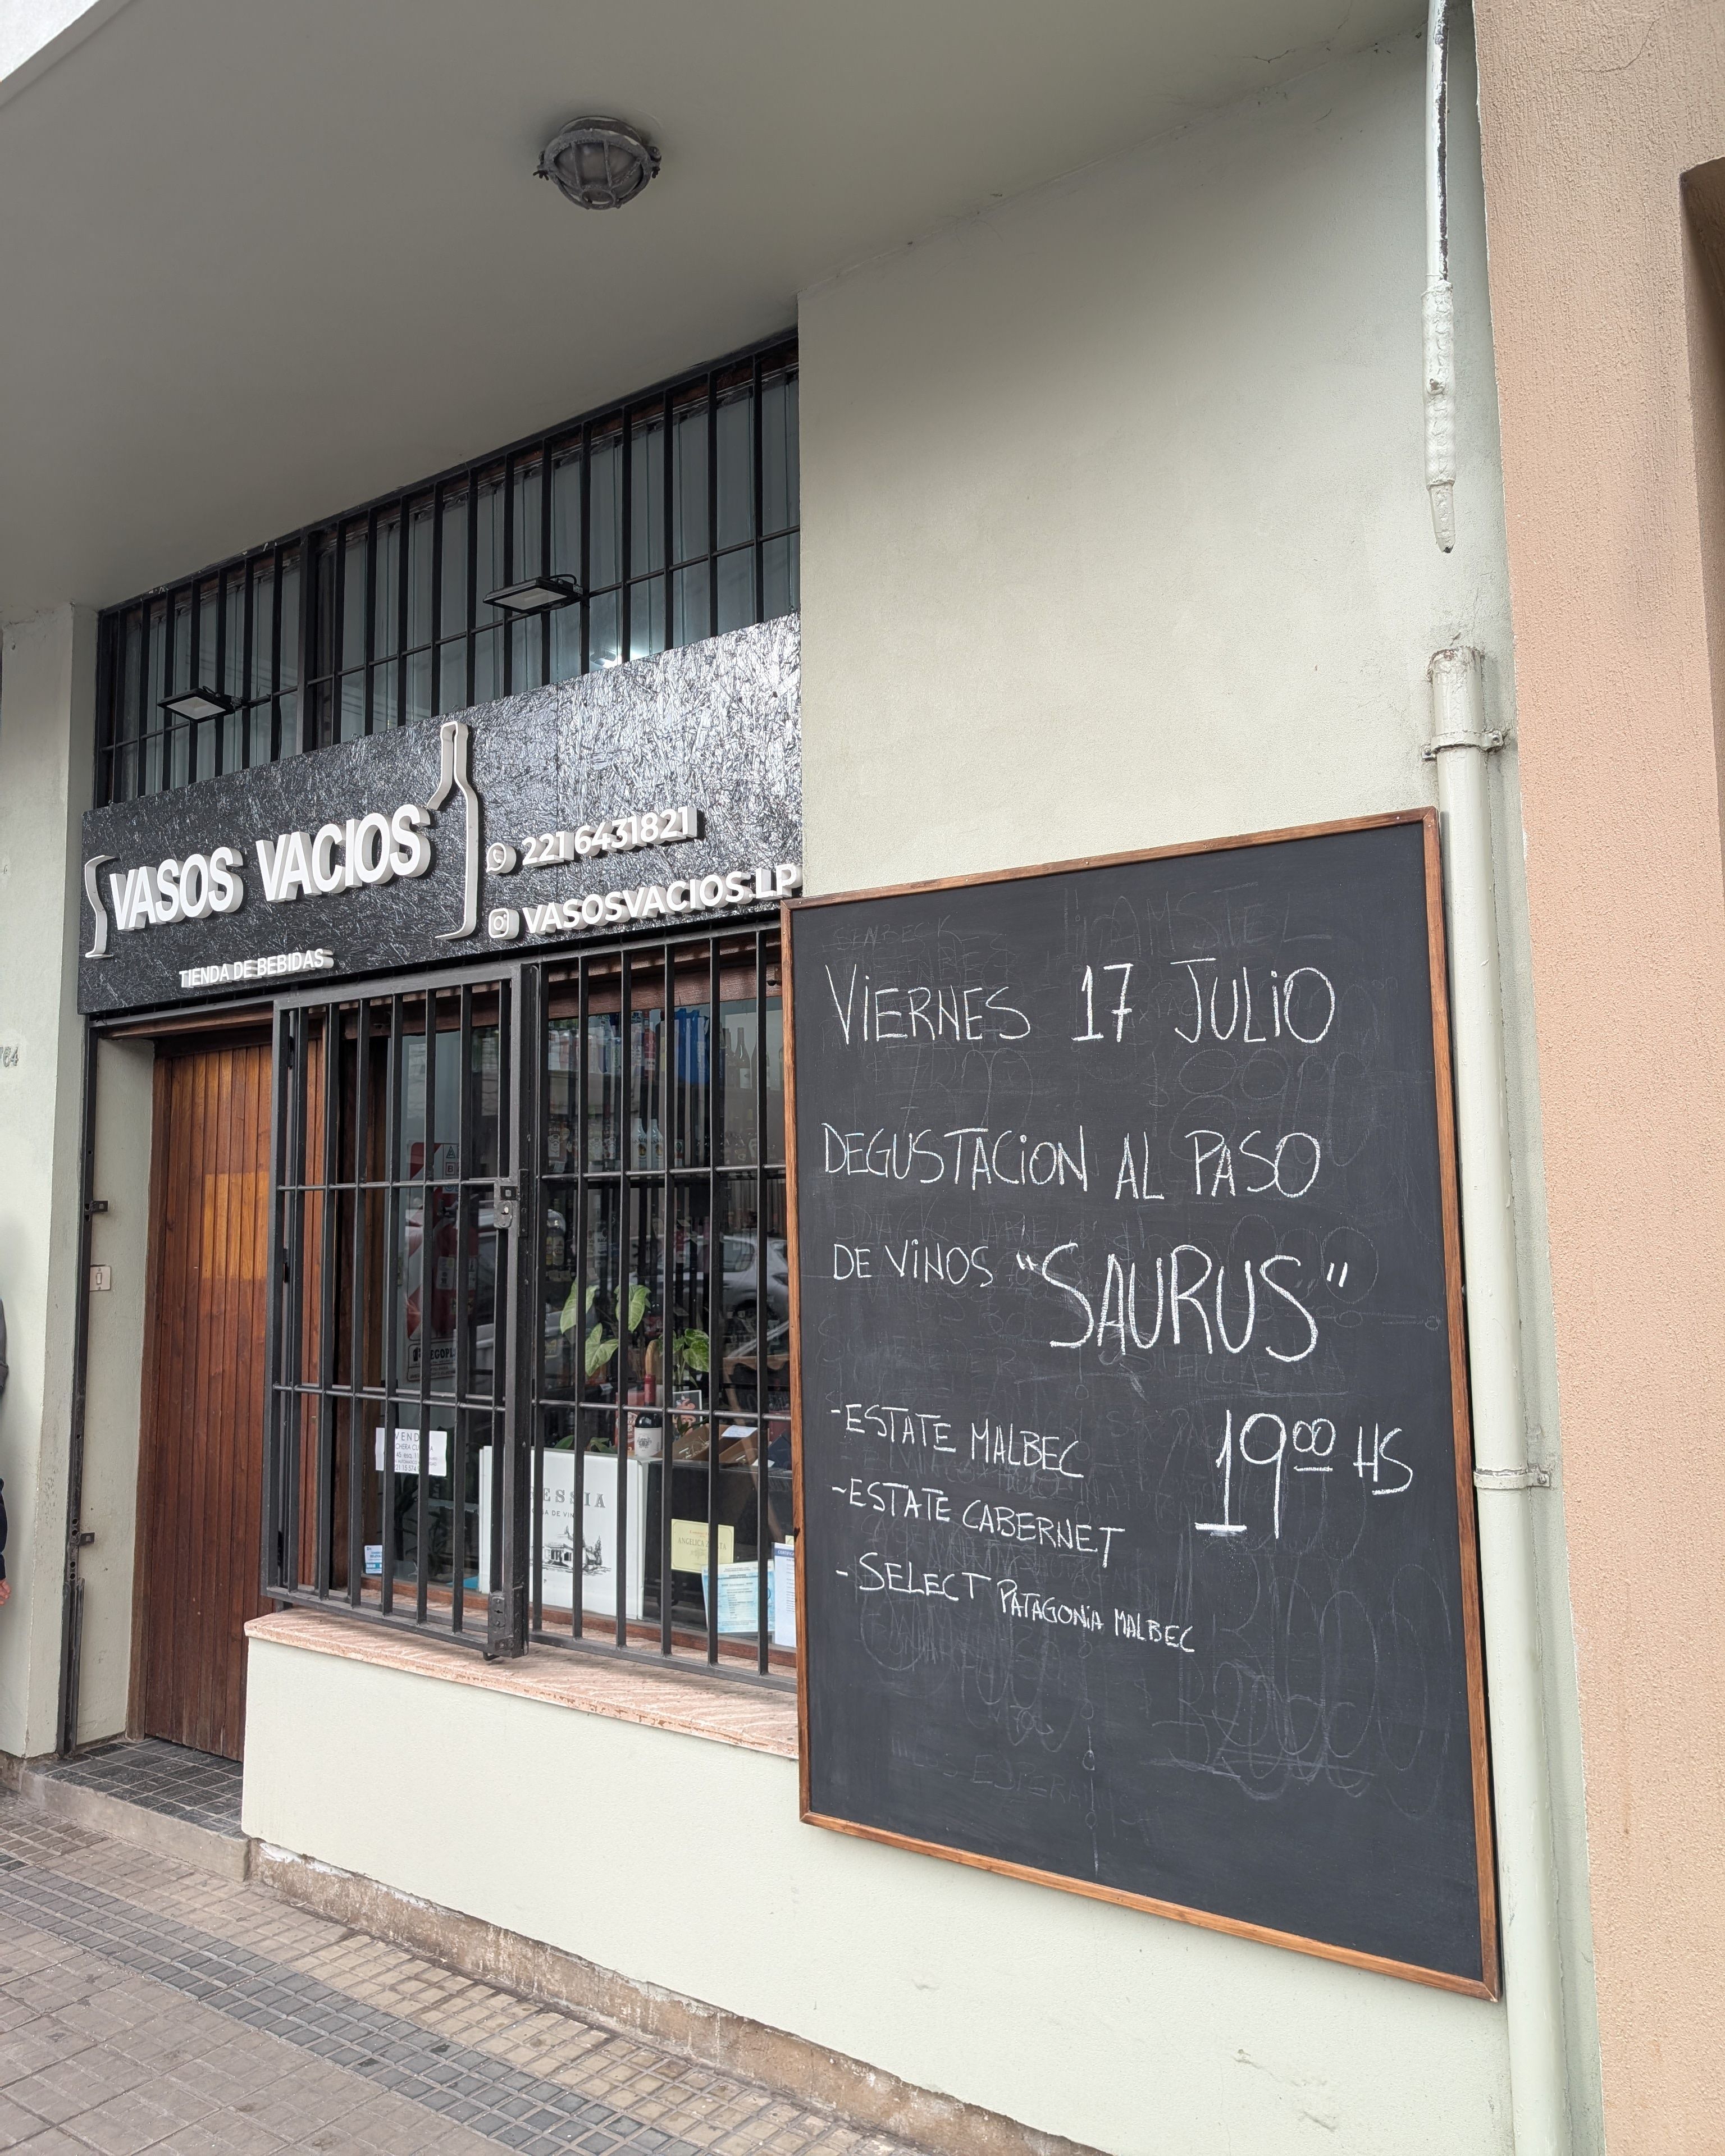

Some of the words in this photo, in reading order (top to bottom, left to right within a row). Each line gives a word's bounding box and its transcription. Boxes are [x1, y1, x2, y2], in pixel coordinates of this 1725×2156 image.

[522, 831, 574, 867] 221
[574, 806, 697, 856] 6431821
[109, 847, 243, 931] VASOS
[255, 804, 431, 902] VACIOS
[522, 863, 802, 935] VASOSVACIOS.LP
[179, 964, 231, 988] TIENDA
[232, 959, 258, 981] DE
[257, 949, 334, 976] BEBIDAS
[1072, 963, 1134, 1043] 17
[1115, 1130, 1164, 1201] AL
[1184, 1129, 1320, 1200] PASO
[833, 1243, 871, 1281] DE
[395, 1432, 419, 1442] VEND
[971, 1418, 1084, 1478] MALBEC
[1353, 1422, 1413, 1495] HS
[678, 1537, 704, 1547] ANGELICA
[963, 1499, 1125, 1568] CABERNET
[1114, 1607, 1195, 1652] MALBEC
